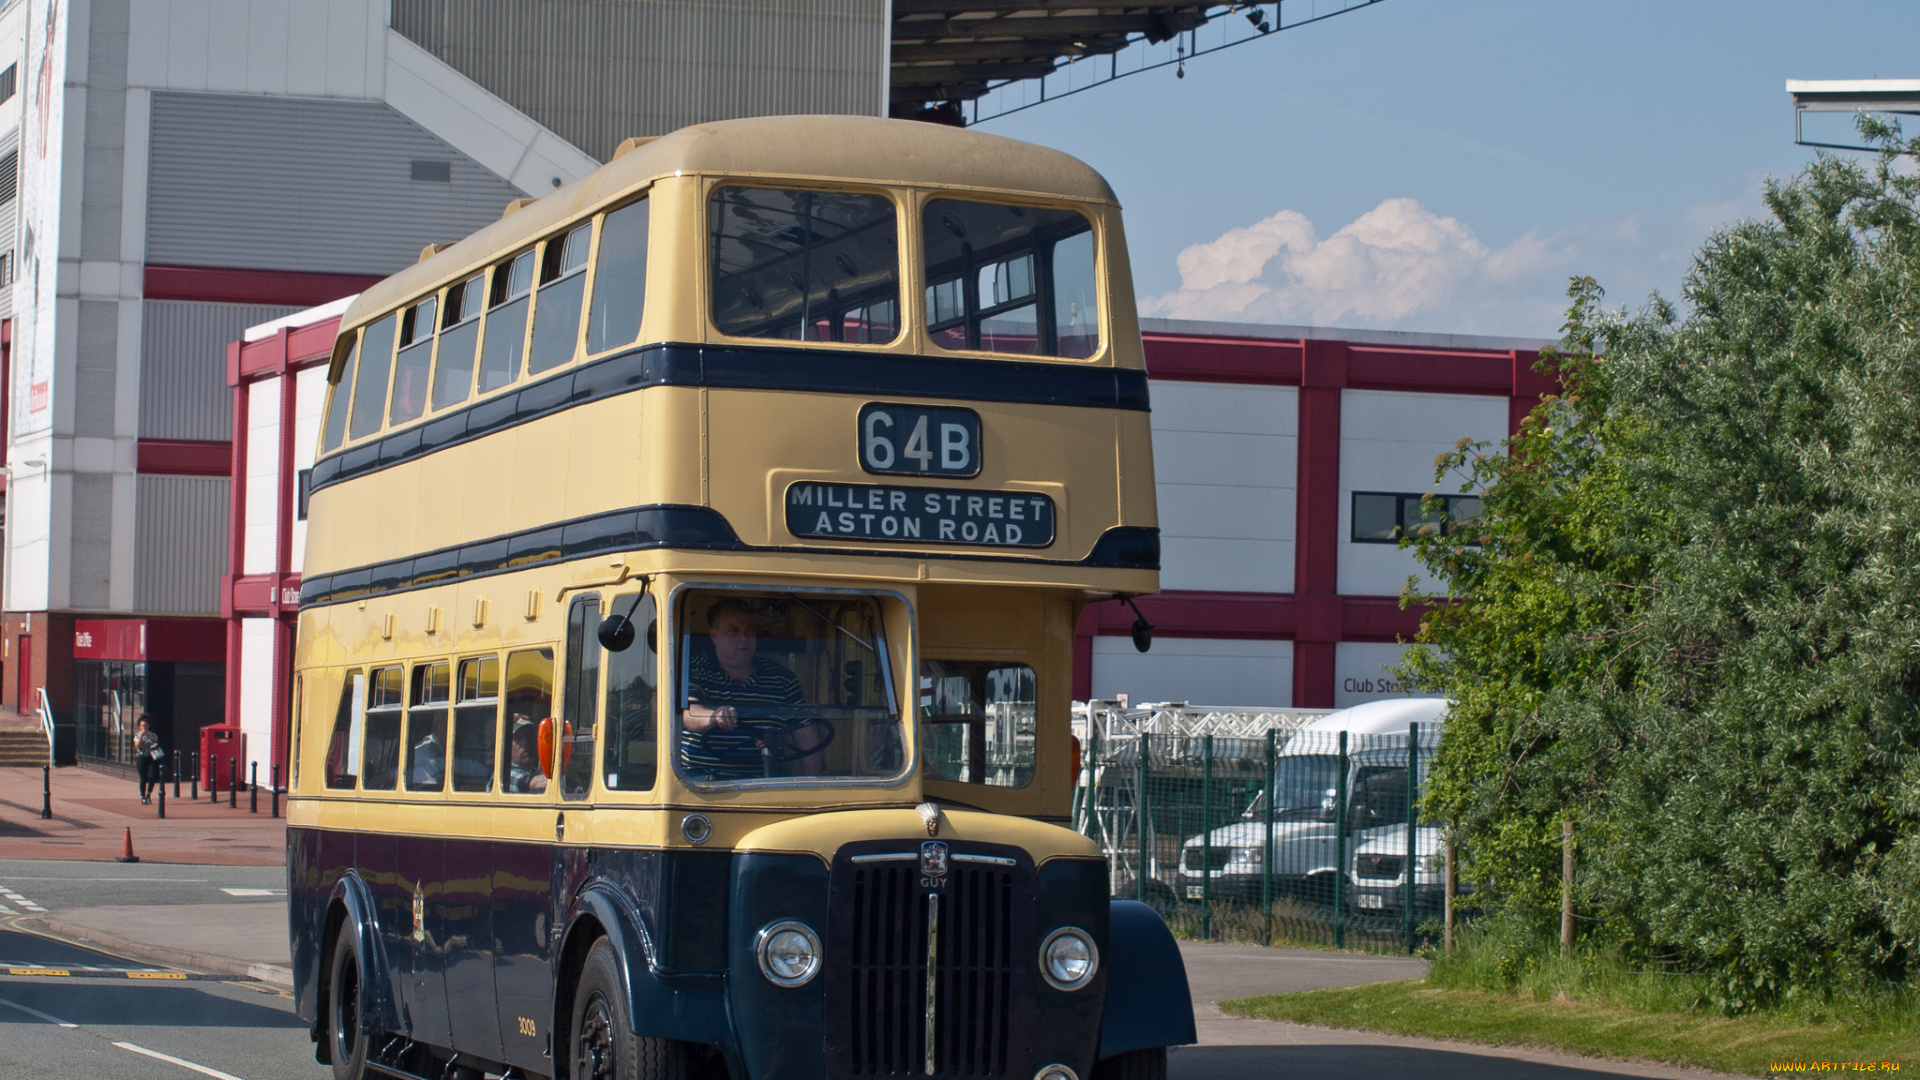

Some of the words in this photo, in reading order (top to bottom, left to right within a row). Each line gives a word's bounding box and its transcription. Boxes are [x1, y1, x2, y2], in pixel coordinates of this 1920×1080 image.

[865, 410, 970, 471] 64B
[791, 485, 907, 512] MILLER
[924, 493, 1045, 521] STREET
[815, 511, 921, 539] ASTON
[939, 518, 1023, 545] ROAD
[1344, 678, 1373, 694] Club
[920, 877, 948, 889] GUY
[517, 1016, 537, 1038] 3009
